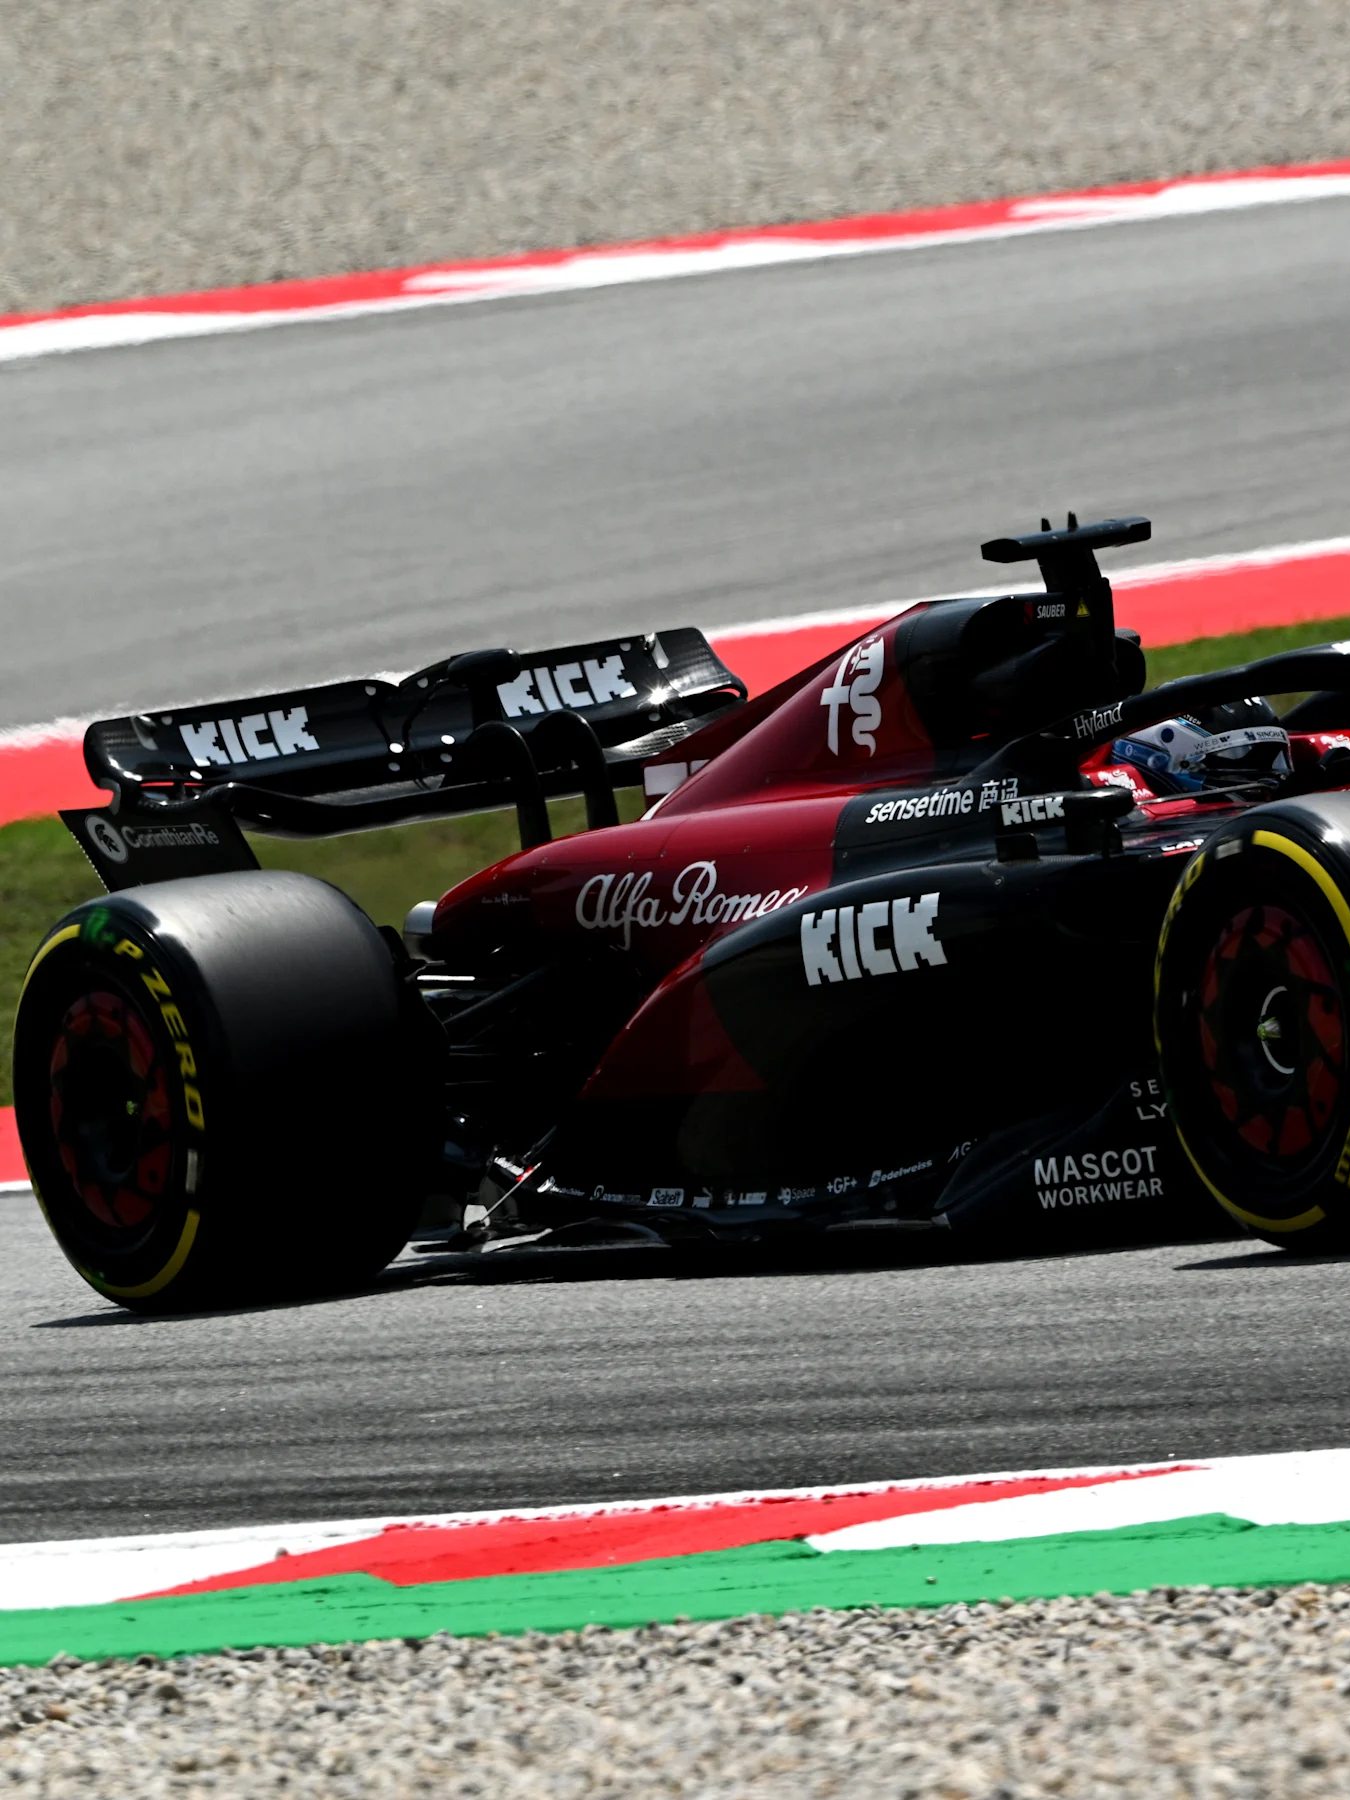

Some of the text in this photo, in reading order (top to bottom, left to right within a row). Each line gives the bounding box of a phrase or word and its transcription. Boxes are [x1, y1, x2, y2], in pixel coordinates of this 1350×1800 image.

[1036, 603, 1066, 619] SAUBER
[496, 654, 638, 719] KICK
[179, 705, 320, 767] KICK
[1073, 701, 1124, 740] Hyland
[865, 787, 973, 824] sensetime
[1001, 796, 1066, 826] KICK
[574, 859, 809, 951] Alfa Romeo
[800, 891, 949, 987] KICK
[139, 965, 206, 1133] ZERO
[1033, 1145, 1158, 1186] MASCOT
[1036, 1177, 1165, 1210] WORKWEAR
